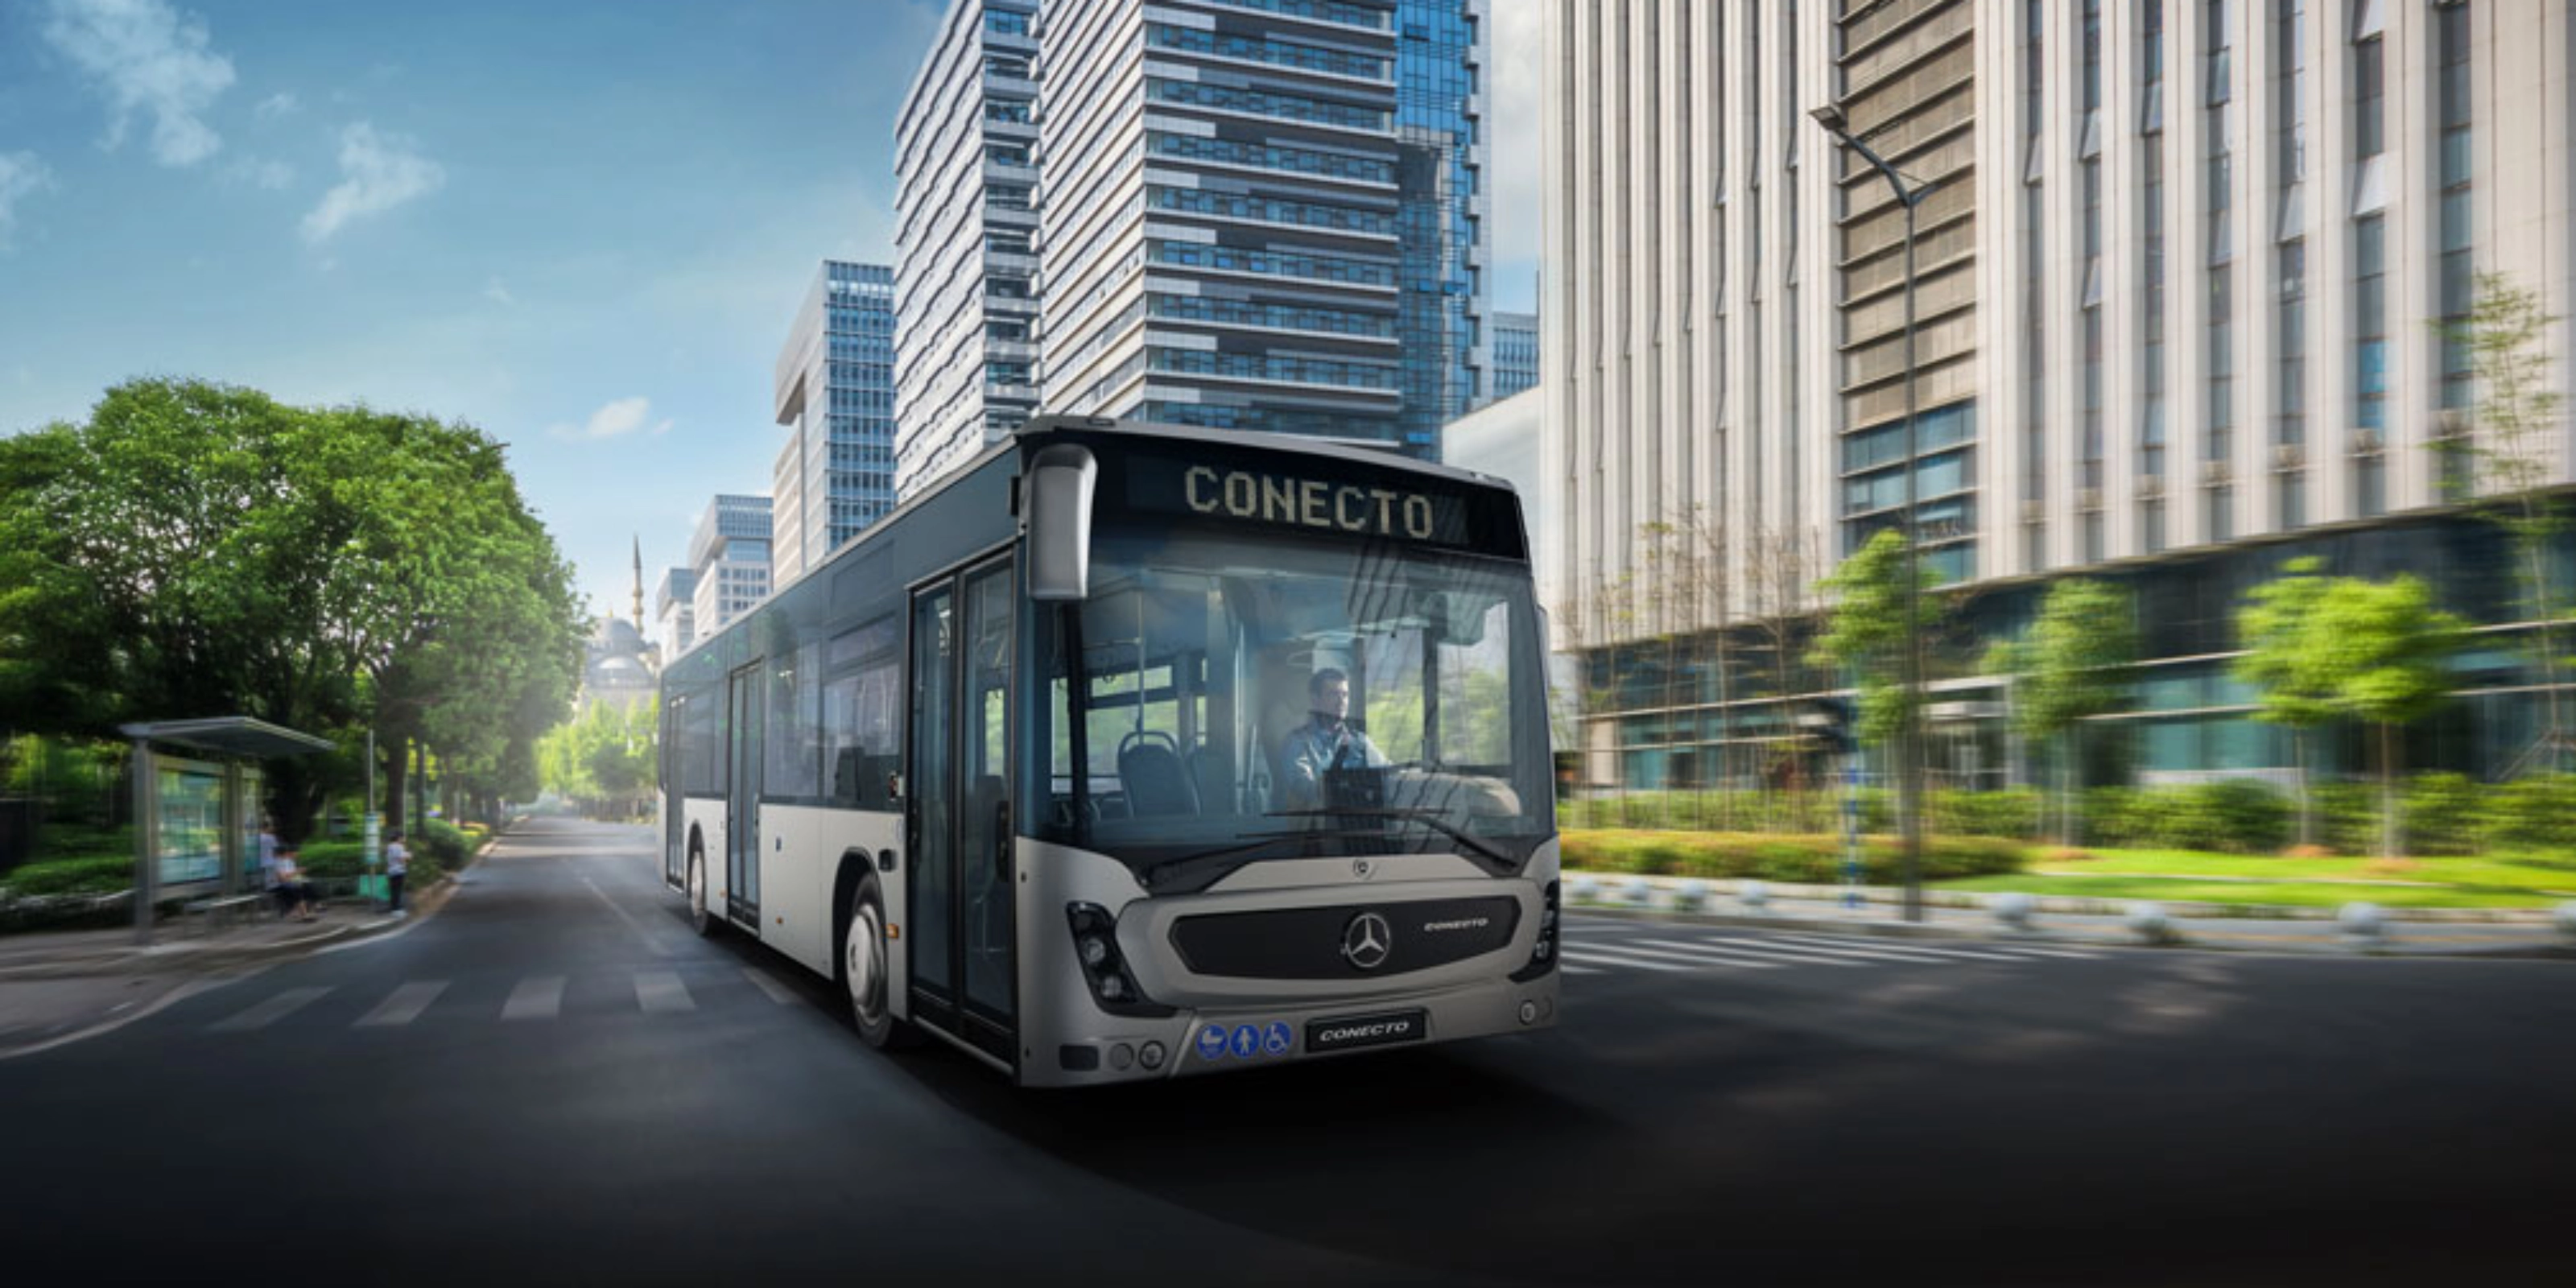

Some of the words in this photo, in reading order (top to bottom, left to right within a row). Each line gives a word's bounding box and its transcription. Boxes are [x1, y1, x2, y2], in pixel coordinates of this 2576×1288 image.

[1186, 465, 1433, 539] CONECTO
[1424, 917, 1489, 931] CONECTO
[1319, 1022, 1410, 1042] CONECTO
